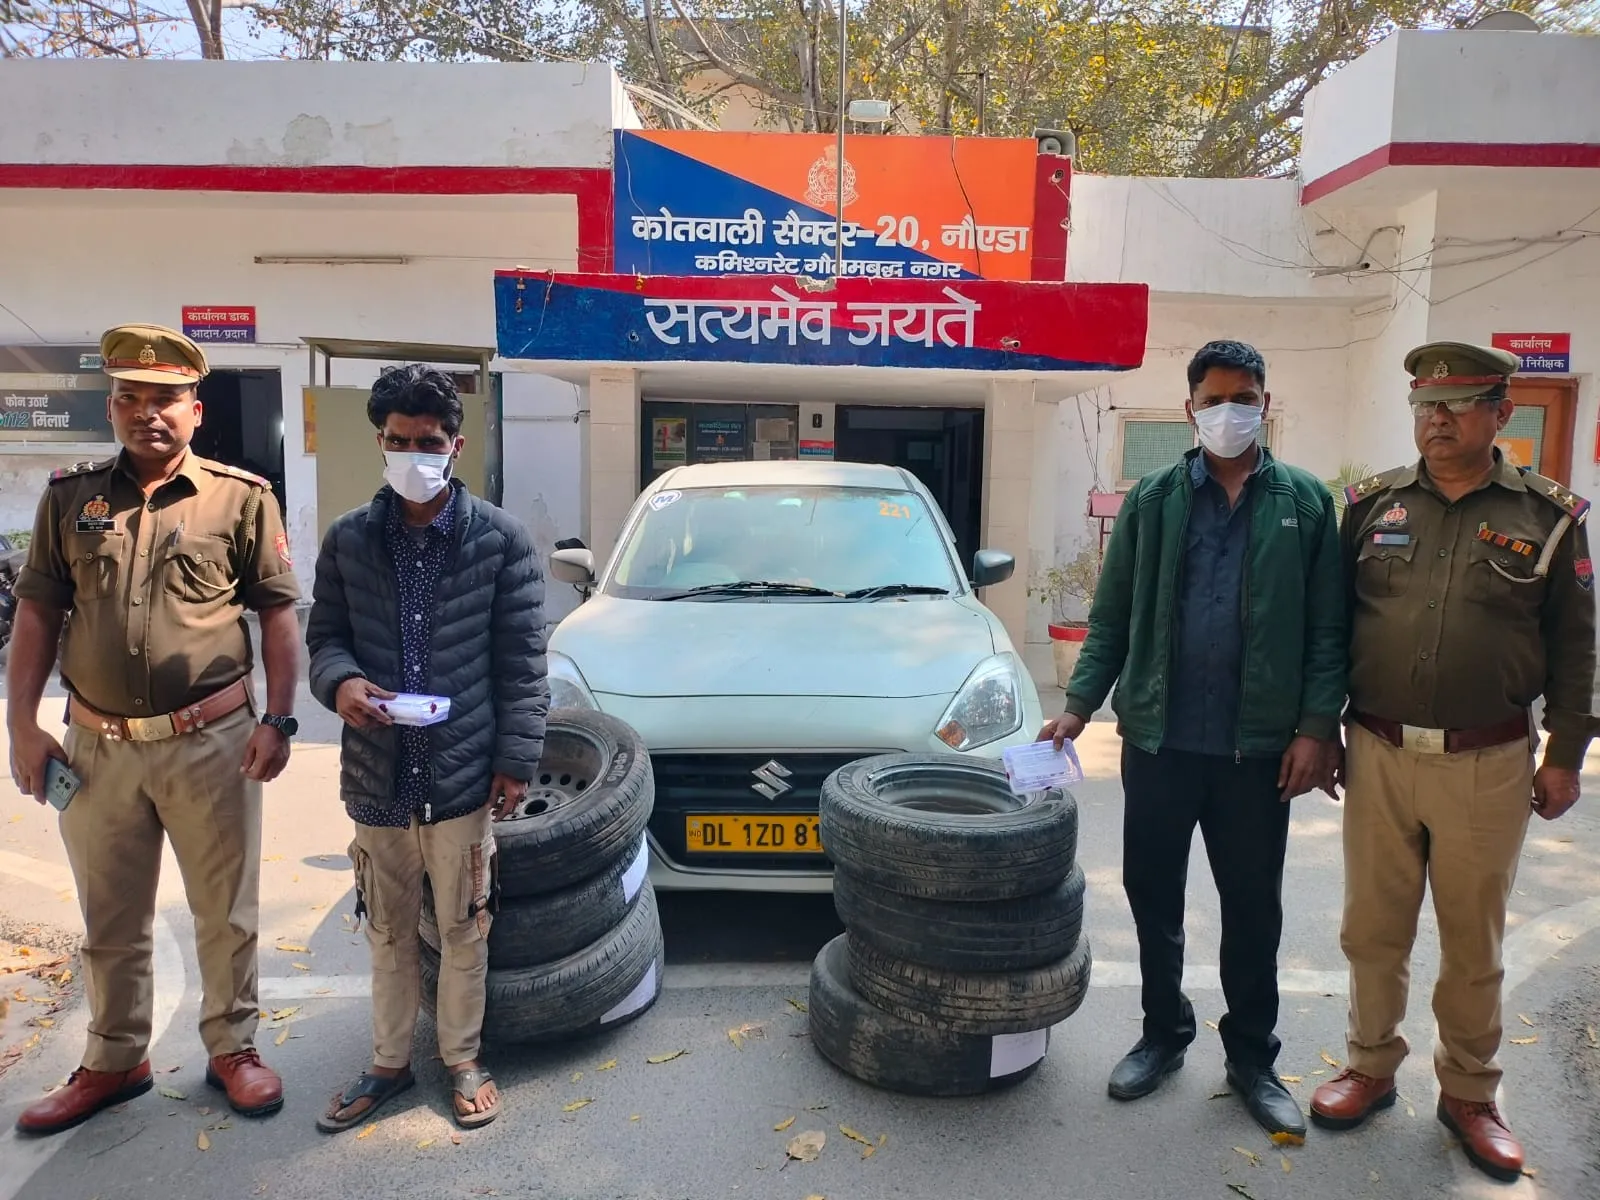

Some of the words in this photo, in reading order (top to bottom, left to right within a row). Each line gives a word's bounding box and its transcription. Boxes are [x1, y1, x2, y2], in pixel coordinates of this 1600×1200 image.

[631, 206, 766, 245] कोतवाली
[940, 214, 1030, 254] नौएडा
[694, 250, 801, 274] कमिश्नरेट
[910, 260, 964, 278] नगर
[187, 308, 227, 321] कार्यालय
[228, 312, 250, 322] डाक
[643, 284, 838, 346] सत्यमेव
[846, 285, 982, 348] जयते
[191, 329, 248, 340] आदान/प्रदान
[1509, 335, 1553, 349] कार्यालय
[1526, 355, 1565, 370] निरीक्षक
[4, 393, 26, 408] फोन
[27, 393, 49, 408] उठाएं
[31, 410, 71, 428] मिलाएं
[702, 823, 732, 847] DL
[742, 823, 785, 847] 1ZD
